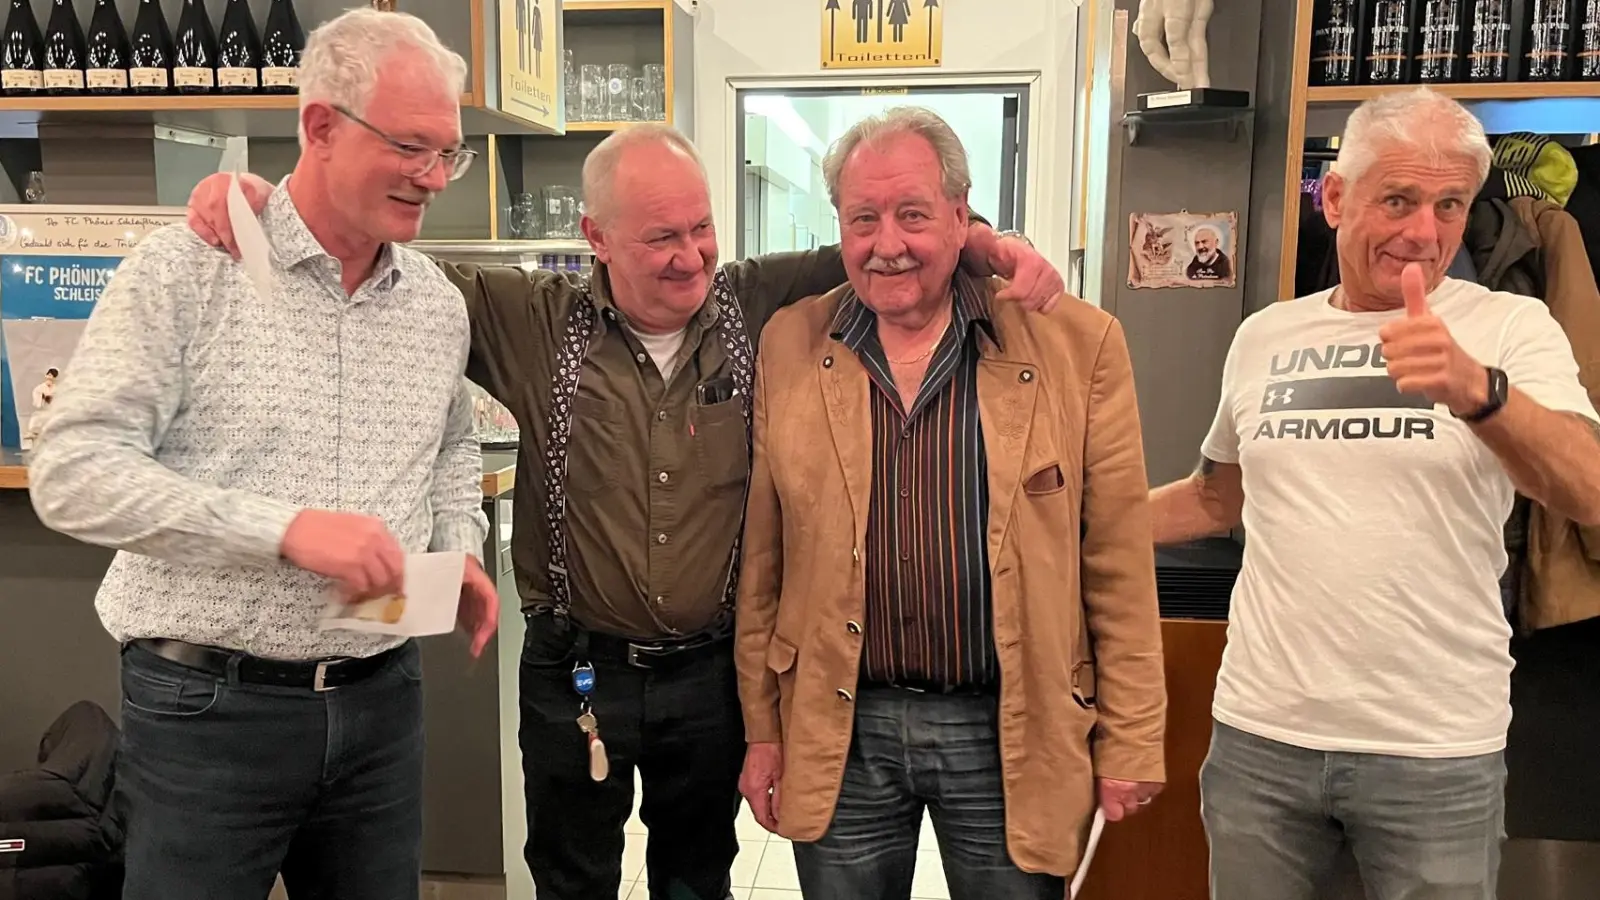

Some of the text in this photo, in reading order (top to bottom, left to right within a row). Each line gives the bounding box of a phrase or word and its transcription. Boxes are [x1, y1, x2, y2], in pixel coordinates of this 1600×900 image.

[836, 52, 926, 62] Toiletten
[509, 74, 551, 104] Toiletten
[25, 264, 107, 286] FC PHÖNIX
[54, 287, 103, 302] SCHLEIS
[1270, 343, 1388, 376] UND
[1252, 416, 1435, 440] ARMOUR
